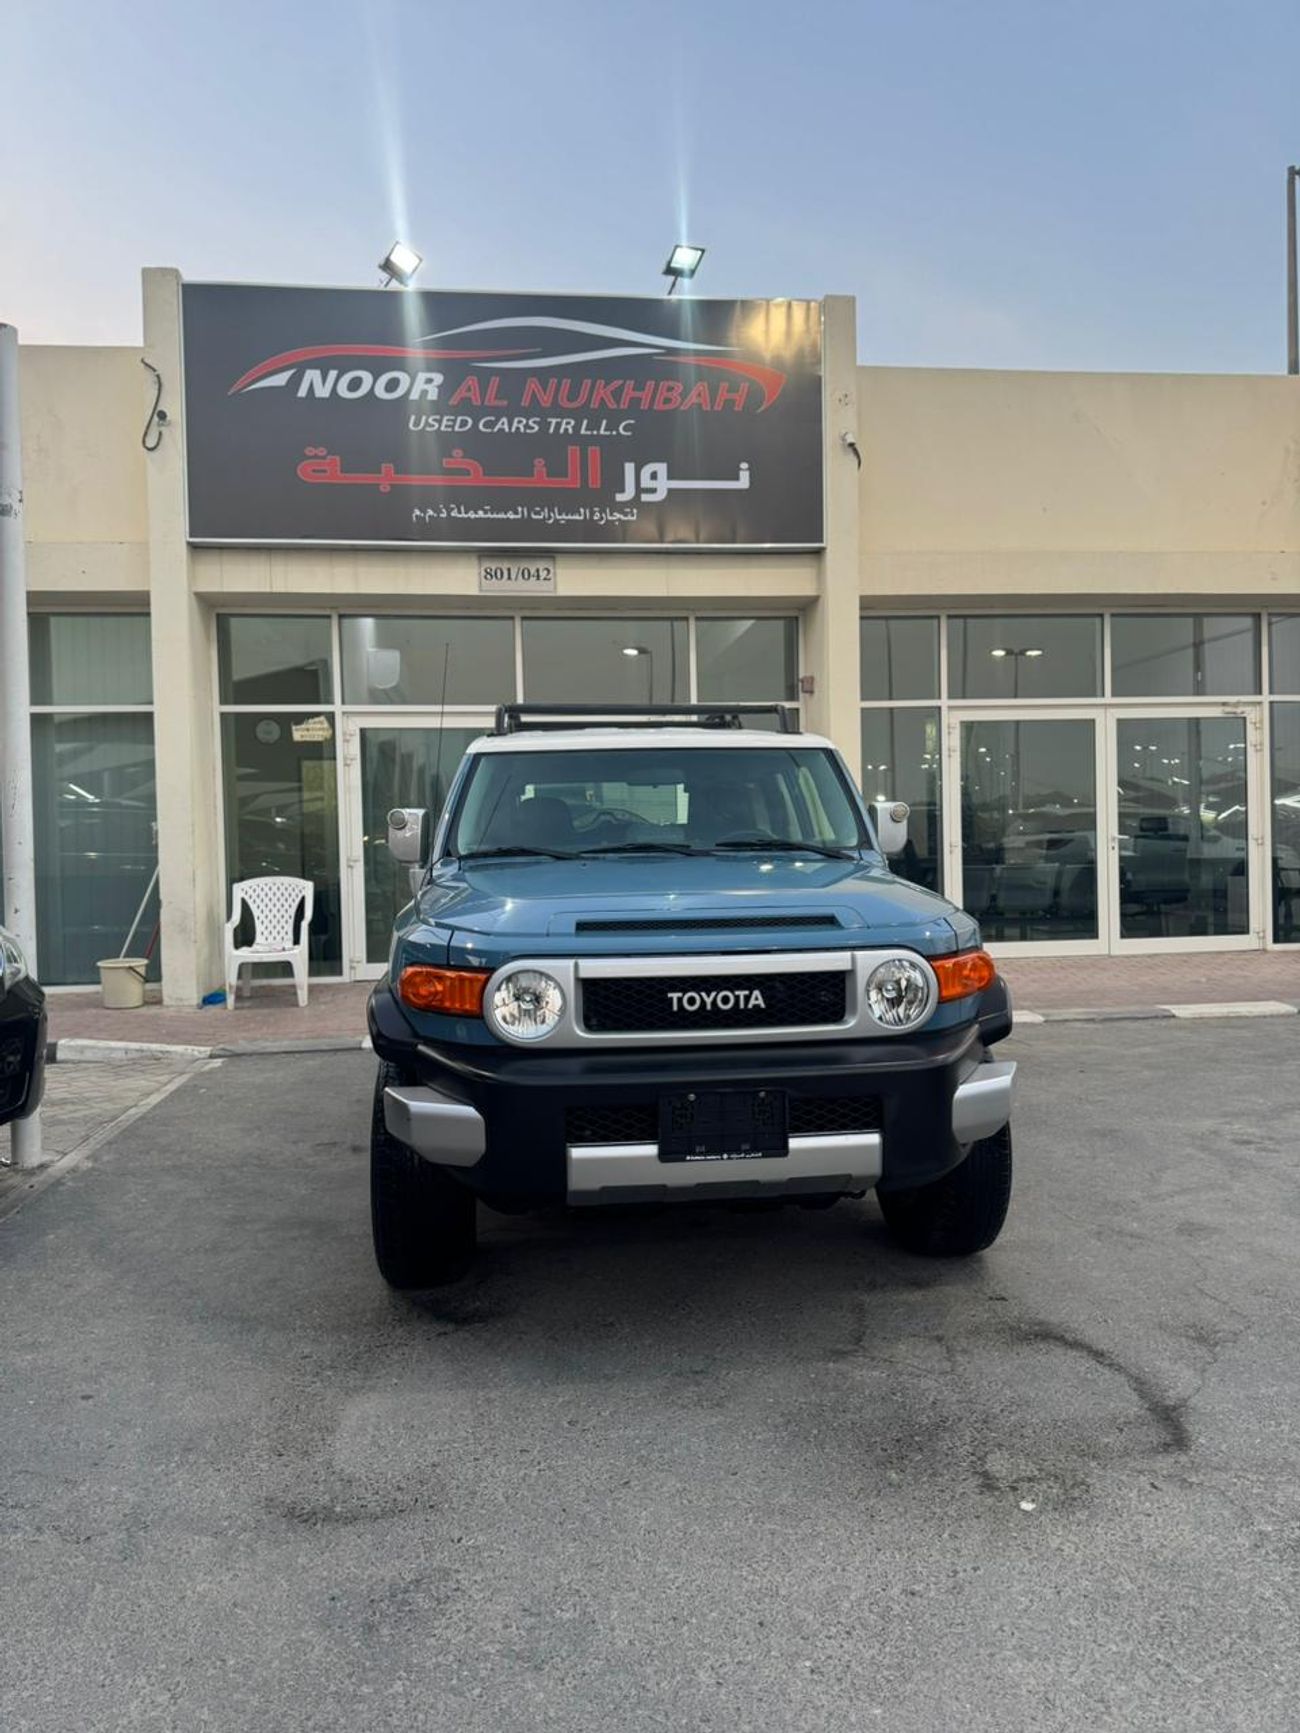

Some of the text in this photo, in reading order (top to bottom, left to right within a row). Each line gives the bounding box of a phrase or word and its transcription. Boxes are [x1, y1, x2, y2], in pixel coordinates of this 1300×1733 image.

[297, 368, 750, 412] NOOR AL NUKHBAH
[408, 415, 636, 436] USED CARS TR L.L.C
[296, 445, 751, 503] نور النخبة
[450, 503, 528, 521] المستعملة
[530, 506, 590, 525] السيارات
[592, 506, 638, 525] لتجارة
[483, 566, 552, 582] 801/042
[667, 989, 767, 1012] TOYOTA
